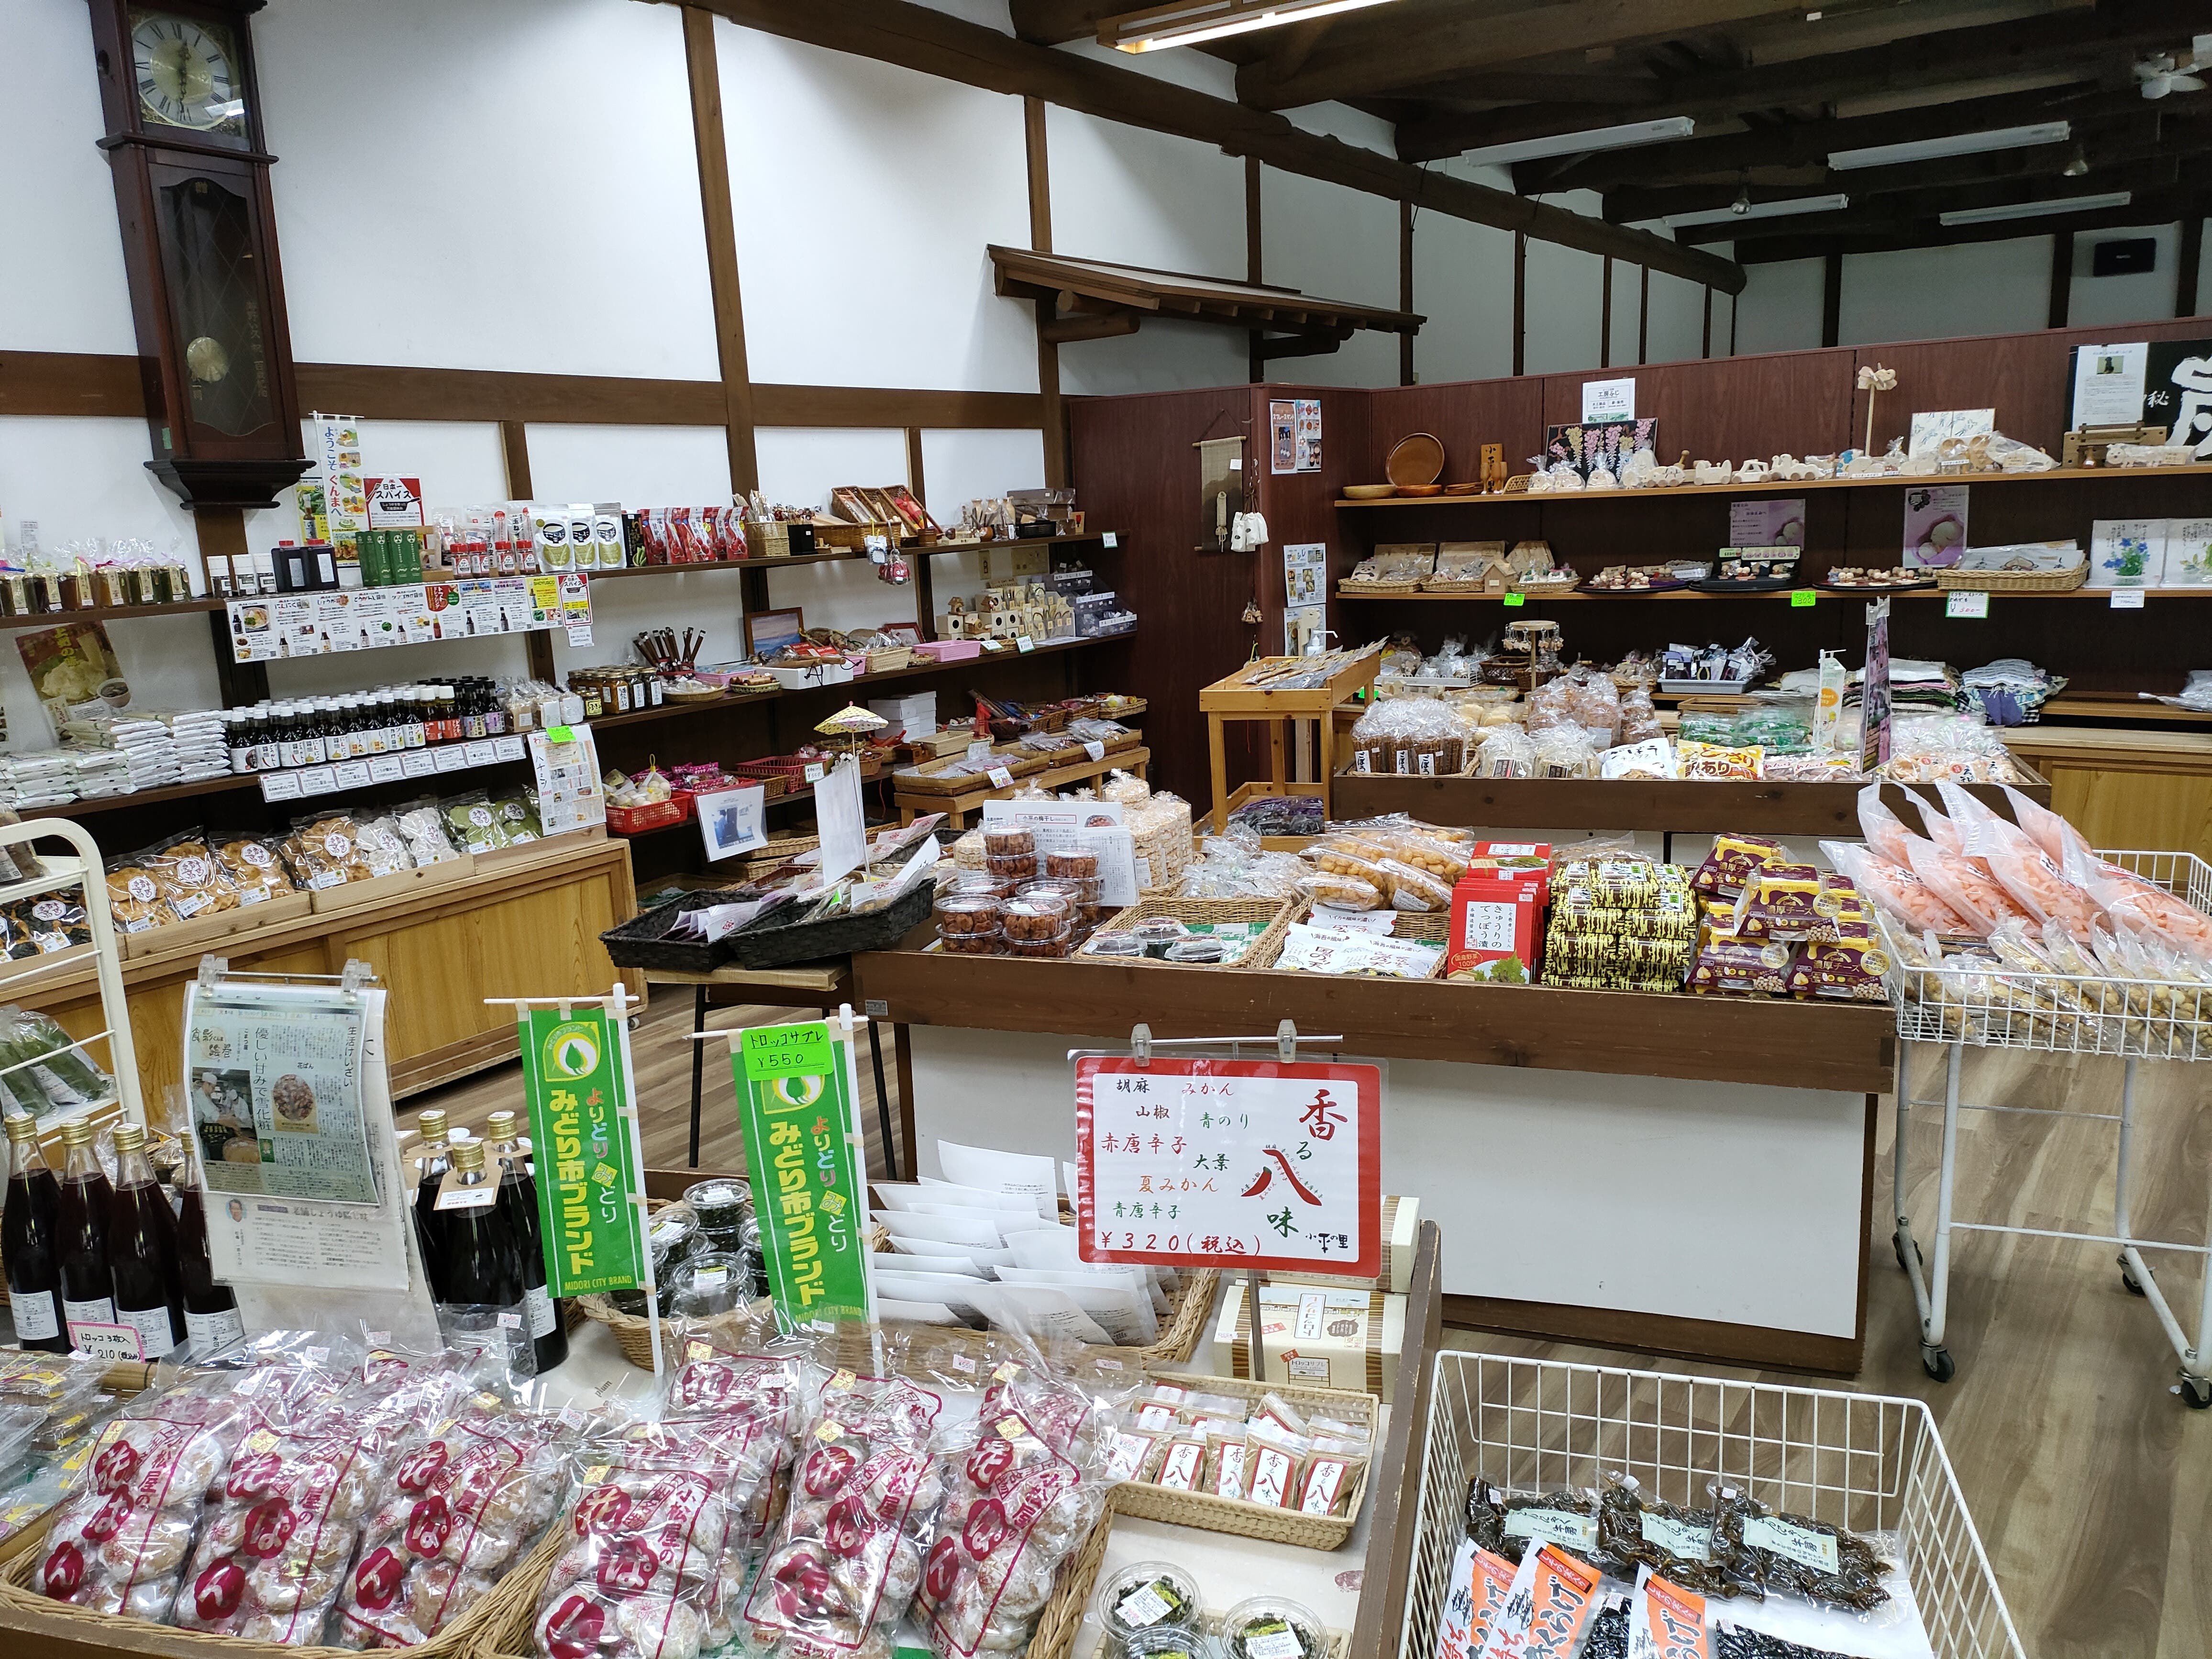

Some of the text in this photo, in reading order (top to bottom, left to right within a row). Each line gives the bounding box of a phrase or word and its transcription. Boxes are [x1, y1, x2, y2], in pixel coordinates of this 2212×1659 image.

[324, 426, 343, 517] ようこそ ぐんまへ
[1485, 446, 1497, 492] 小平里
[375, 490, 412, 499] スパイス
[1700, 747, 1755, 768] どっさり
[535, 755, 547, 789] ハチミツ
[1767, 904, 1813, 916] 濃厚チーズ
[1478, 905, 1492, 948] てっぽう漬
[1492, 905, 1503, 948] きゅうりの
[1814, 959, 1860, 973] 濃厚チーズ
[751, 1030, 824, 1049] トロッコサブレ
[297, 1062, 314, 1070] 花ぱん
[343, 1026, 357, 1087] 生活けいざい
[757, 1053, 805, 1069] ¥550
[253, 1027, 271, 1131] 優しい甘みで雪化粧
[1116, 1077, 1234, 1096] 胡麻 みかん
[1136, 1104, 1170, 1120] 山椒
[1199, 1112, 1249, 1129] 青のり
[1101, 1132, 1187, 1155] 赤唐辛子
[586, 1087, 618, 1224] よりどりみどり
[1193, 1153, 1230, 1172] 大葉
[549, 1089, 594, 1276] みどり市ブランド
[810, 1115, 847, 1253] よりどりみどり
[1139, 1175, 1219, 1194] 夏みかん
[769, 1121, 826, 1306] みどり市ブランド
[1112, 1201, 1182, 1219] 青唐辛子
[1101, 1231, 1261, 1256] ¥320(税込)
[1305, 1233, 1349, 1254] 小平の里
[564, 1274, 632, 1292] MIDORI CITY BRAND
[80, 1332, 131, 1344] トロッコ3枚入
[83, 1345, 115, 1359] ¥ 210
[593, 1380, 614, 1398] plum
[1118, 1439, 1137, 1453] ¥550
[1164, 1446, 1192, 1488] 香る八味
[1256, 1453, 1283, 1499] 香る八味
[1306, 1464, 1336, 1510] 香る八味
[1124, 1610, 1140, 1624] ¥650
[792, 1639, 837, 1659] こまつ屋
